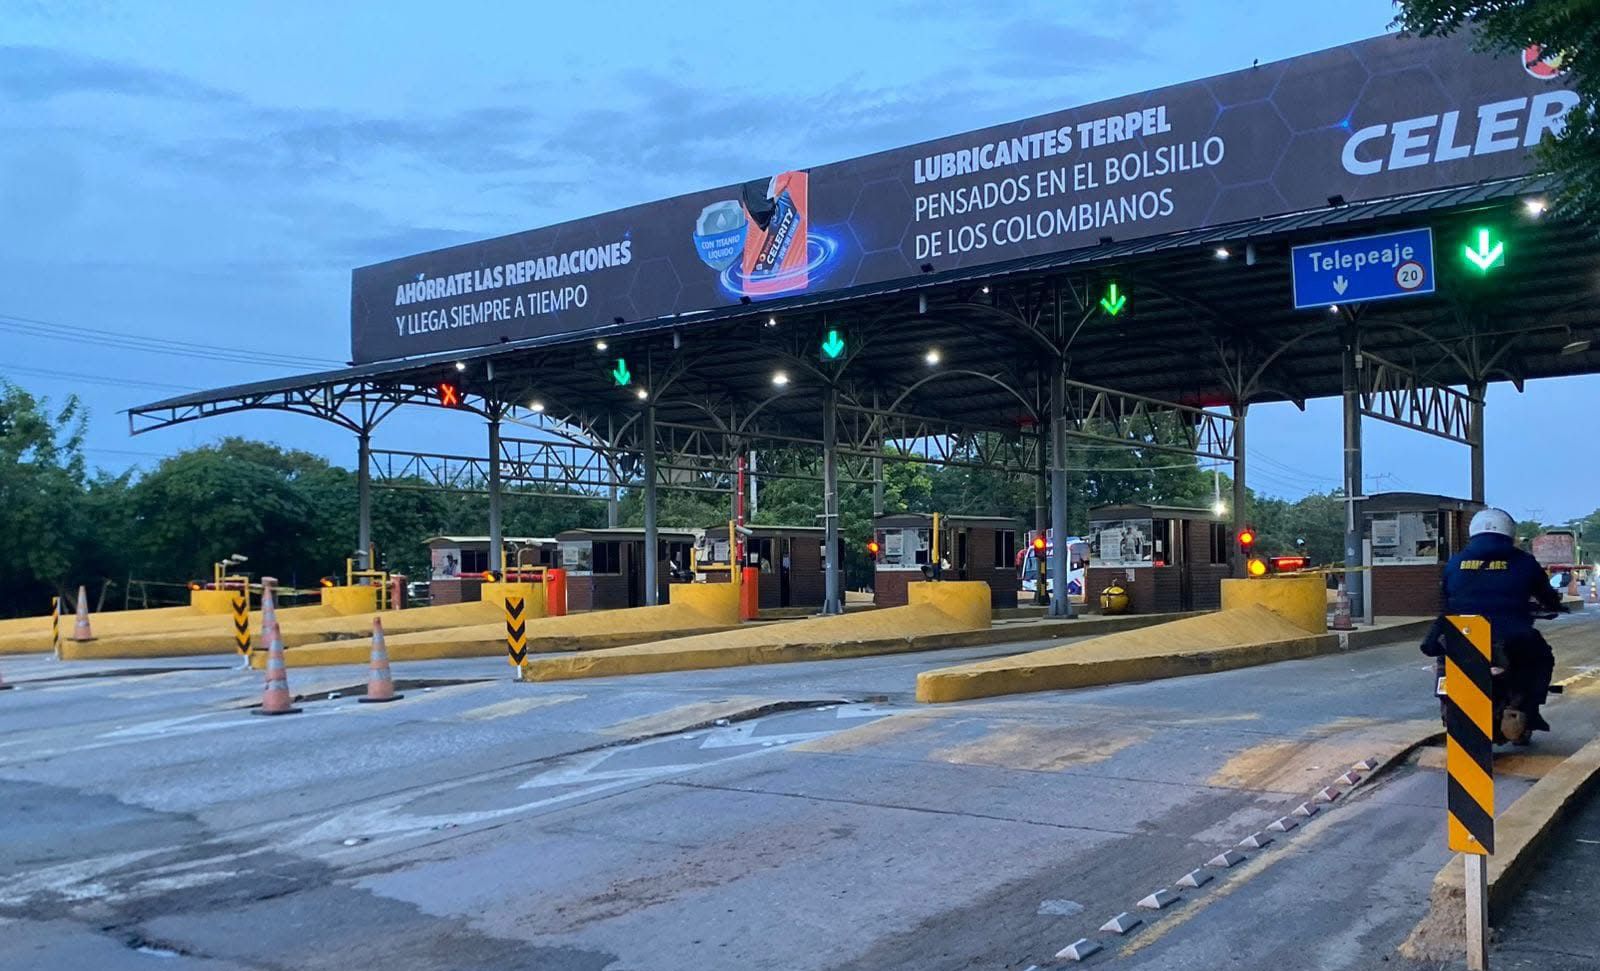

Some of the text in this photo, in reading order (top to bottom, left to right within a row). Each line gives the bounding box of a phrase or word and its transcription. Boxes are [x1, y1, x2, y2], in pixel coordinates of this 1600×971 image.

[914, 105, 1171, 184] LUBRICANTES TERPEL
[1341, 90, 1582, 175] CELER
[915, 136, 1225, 222] PENSADOS EN EL BOLSILLO
[702, 235, 740, 250] CON TITANIO
[767, 208, 794, 265] CELERITY
[915, 188, 1175, 260] DE LOS COLOMBIANOS
[395, 240, 632, 306] AHÓRRATE LAS REPARACIONES
[1309, 243, 1415, 273] Telepeaje
[1402, 270, 1418, 282] 20
[396, 284, 588, 337] Y LLEGA SIEMPRE A TIEMPO
